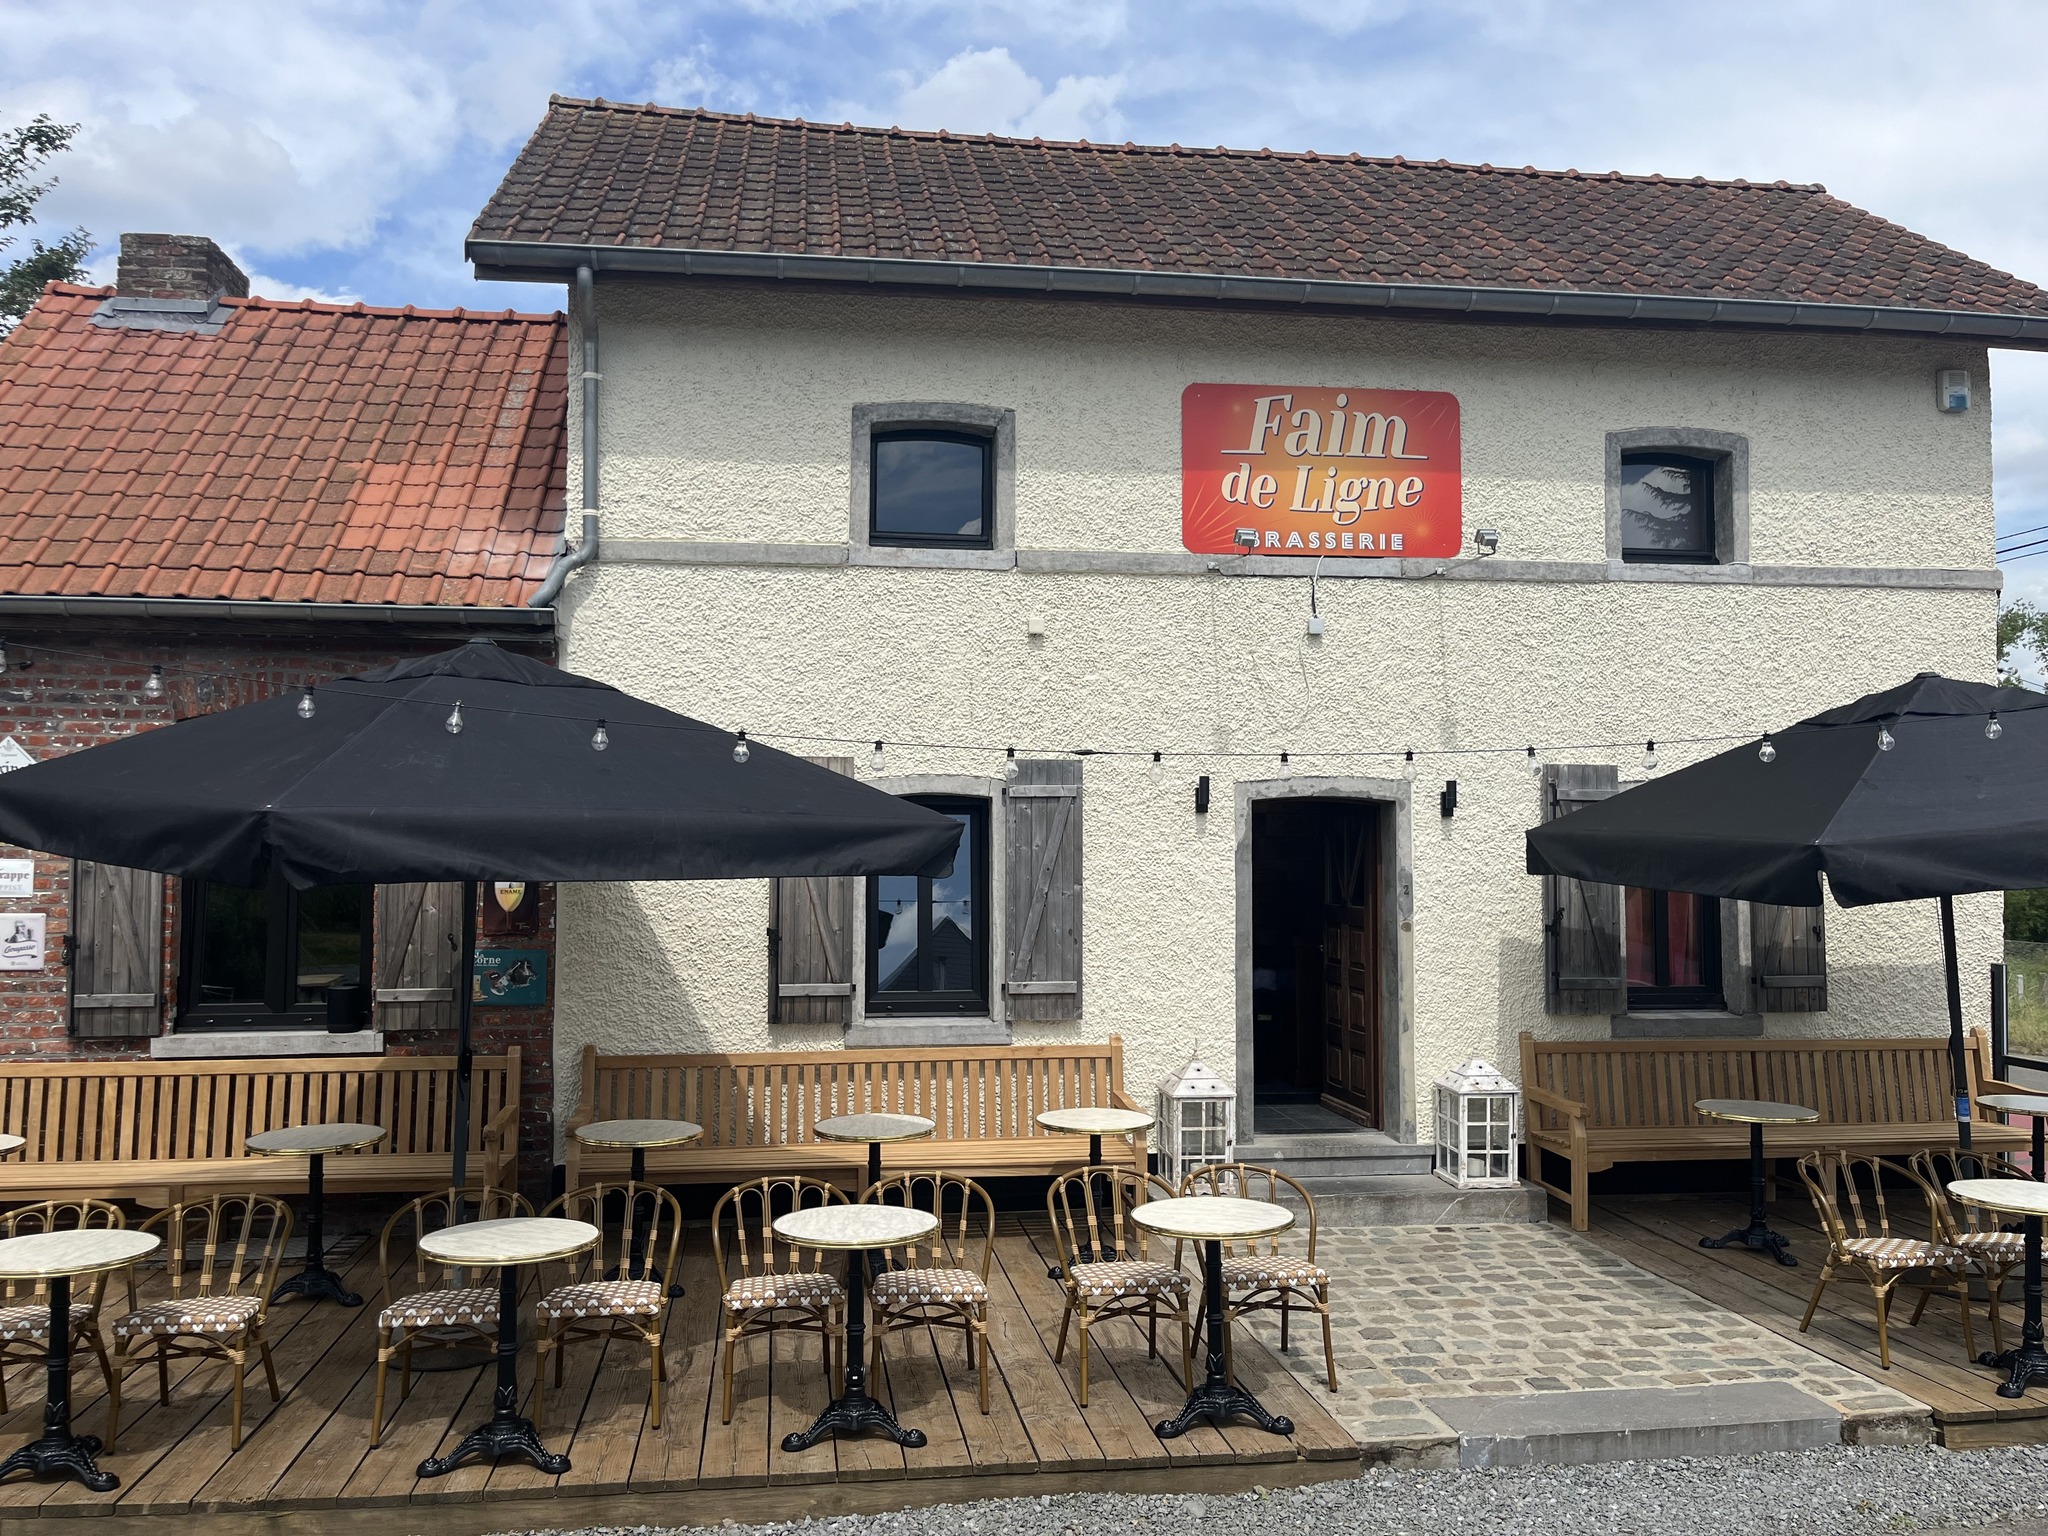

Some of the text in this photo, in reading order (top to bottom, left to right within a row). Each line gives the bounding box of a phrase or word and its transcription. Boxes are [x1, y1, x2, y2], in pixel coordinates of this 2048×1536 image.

[1221, 393, 1429, 460] Faim
[1221, 462, 1425, 525] de Ligne
[1403, 884, 1410, 895] 2
[474, 956, 501, 964] orne
